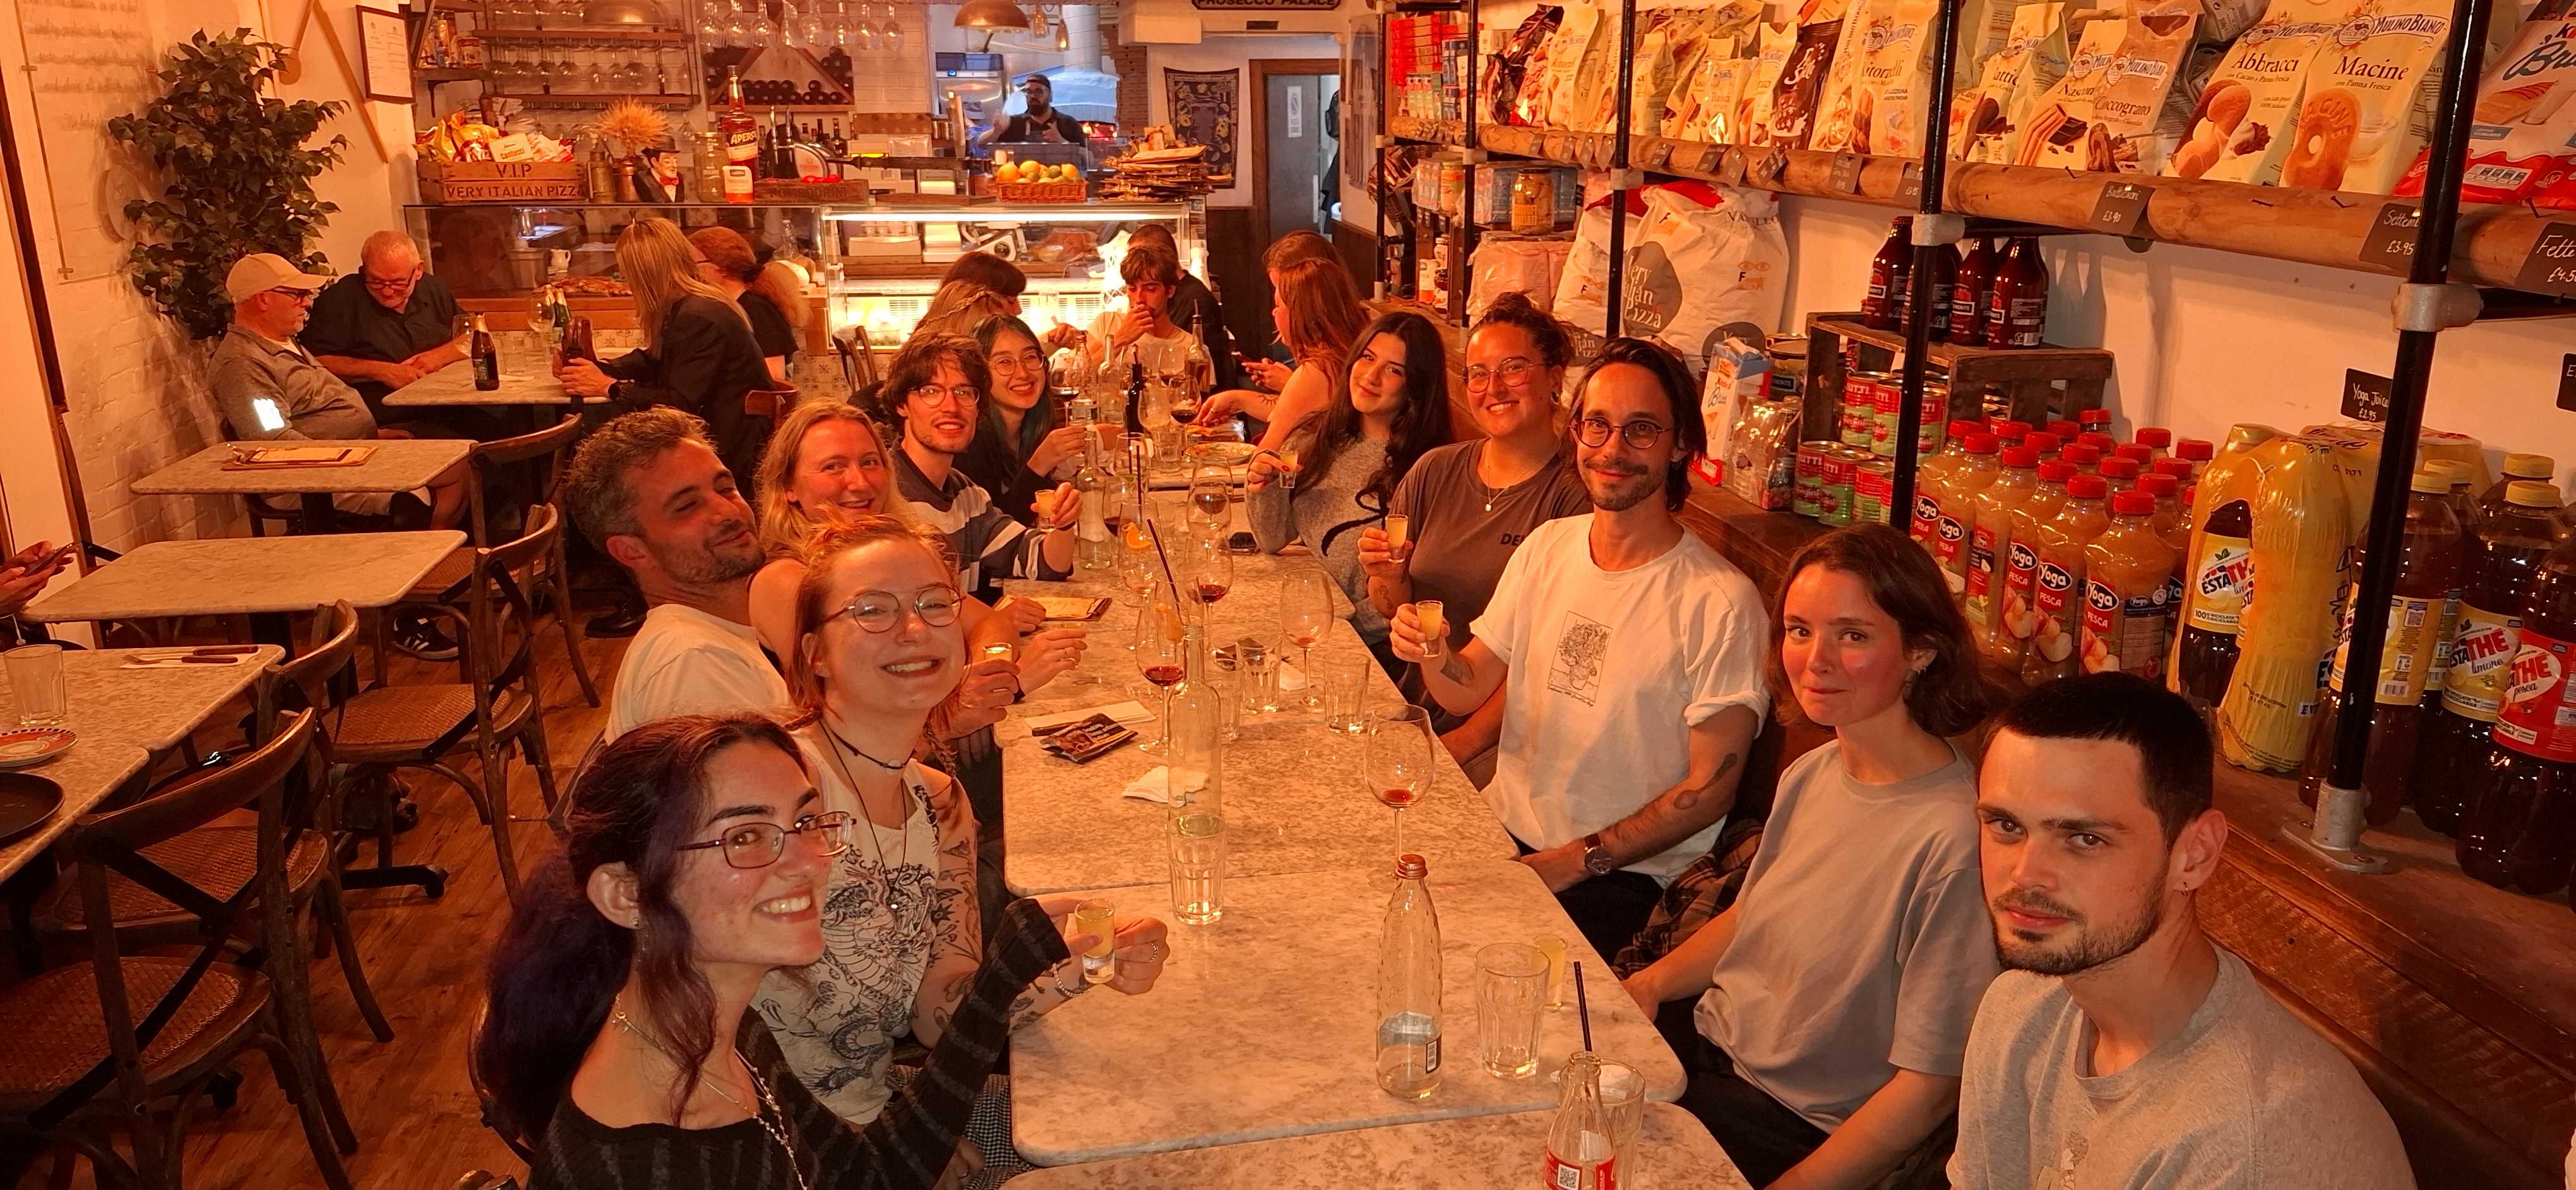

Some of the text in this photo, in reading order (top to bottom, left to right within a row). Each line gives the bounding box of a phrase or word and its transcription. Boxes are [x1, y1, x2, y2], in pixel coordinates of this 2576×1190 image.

[2231, 52, 2303, 73] Abbracci
[2334, 56, 2410, 80] Macine
[2346, 79, 2368, 88] Panna
[2368, 81, 2392, 91] Fresca
[730, 129, 757, 145] APERO
[446, 184, 586, 198] VERY ITALIAN PIZZA
[2352, 382, 2370, 407] Yoga
[1917, 498, 1937, 518] Yoga
[1914, 520, 1929, 533] PERA
[1939, 517, 1960, 538] Yoga
[1939, 541, 1954, 553] PERA
[2010, 544, 2034, 567] Yoga
[2008, 570, 2029, 586] PESCA
[2040, 563, 2066, 587] Yoga
[2039, 592, 2062, 608] PESCA
[2087, 583, 2113, 608] Yoga
[2087, 611, 2109, 628] PESCA
[2471, 658, 2504, 674] limone
[2512, 682, 2538, 702] pesca
